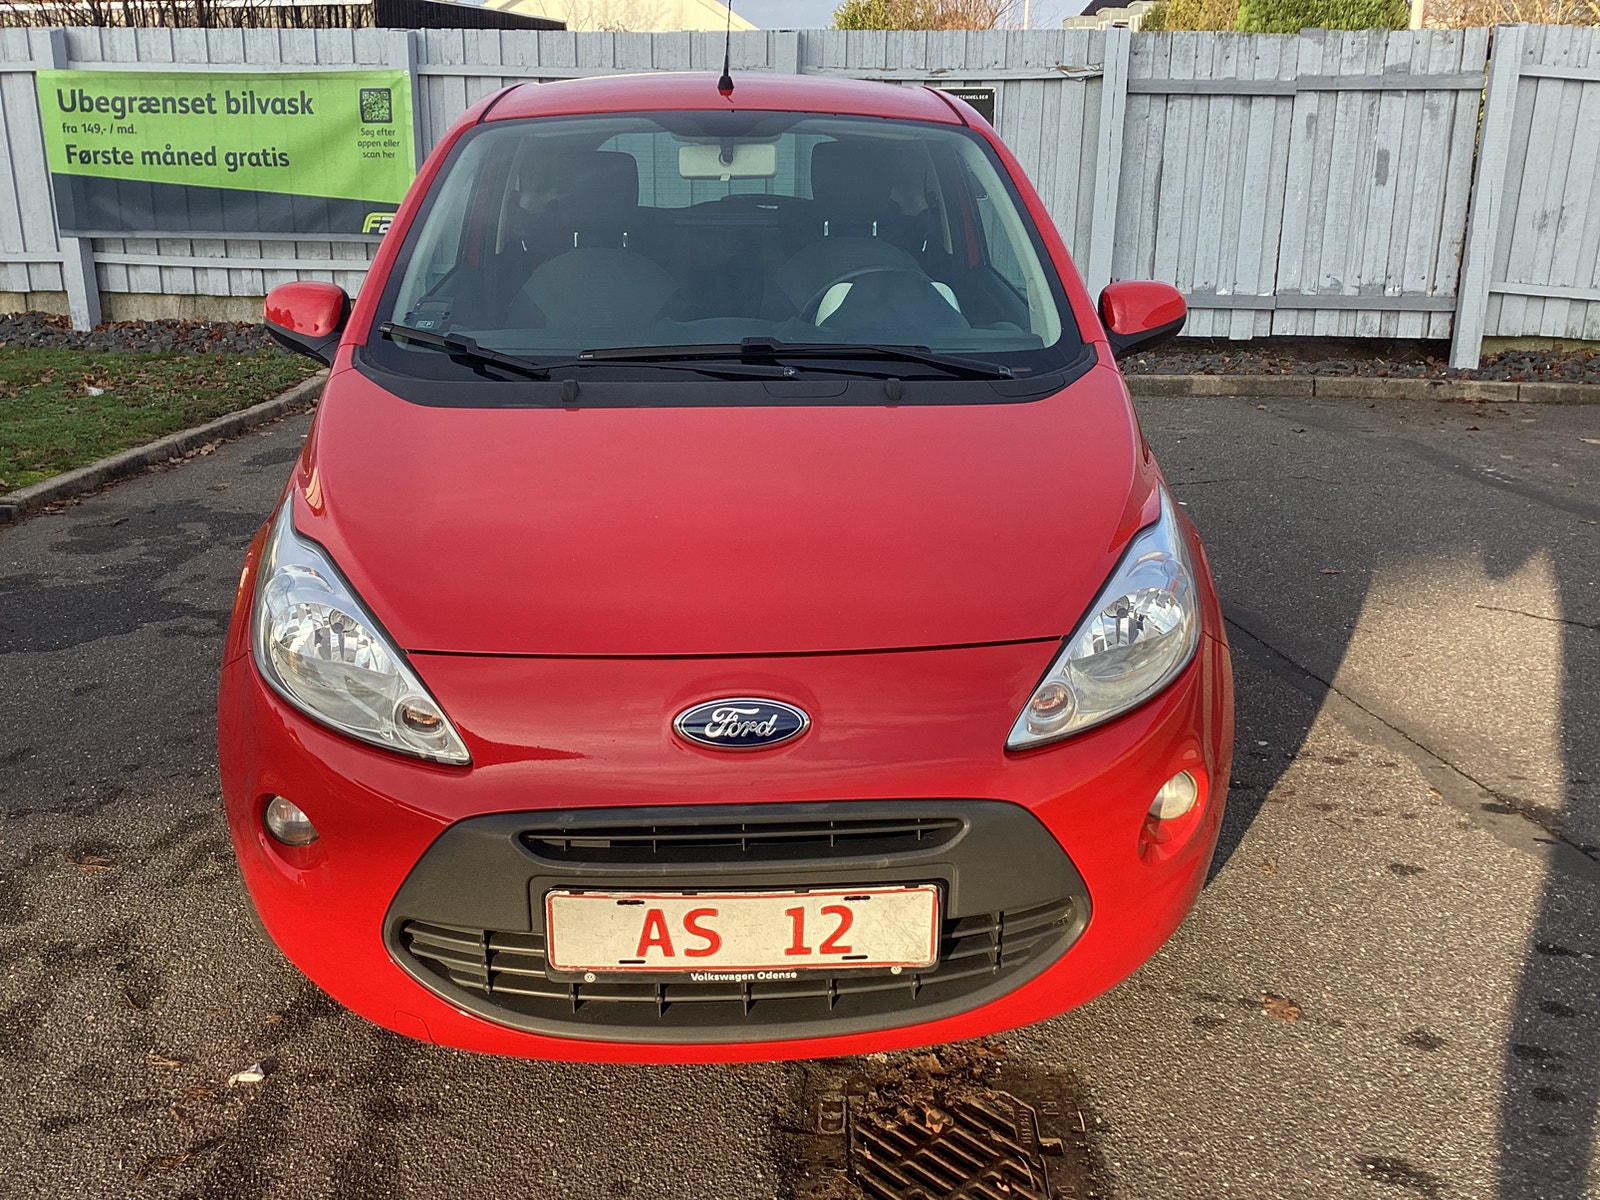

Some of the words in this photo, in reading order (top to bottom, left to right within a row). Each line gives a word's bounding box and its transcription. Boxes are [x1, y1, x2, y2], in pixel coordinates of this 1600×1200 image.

[56, 88, 217, 120] Ubegrænset
[225, 89, 314, 115] bilvask
[62, 122, 78, 134] fra
[117, 123, 138, 134] md.
[376, 127, 396, 136] efter
[357, 140, 382, 149] appen
[383, 139, 400, 147] eller
[65, 144, 134, 165] Første
[141, 145, 217, 167] måned
[224, 147, 290, 173] gratis
[382, 150, 396, 158] her
[362, 212, 395, 234] F2
[704, 707, 778, 738] Ford
[636, 907, 722, 957] AS
[783, 905, 854, 956] 12
[690, 972, 755, 982] Volkswagen
[756, 971, 798, 980] Odense
